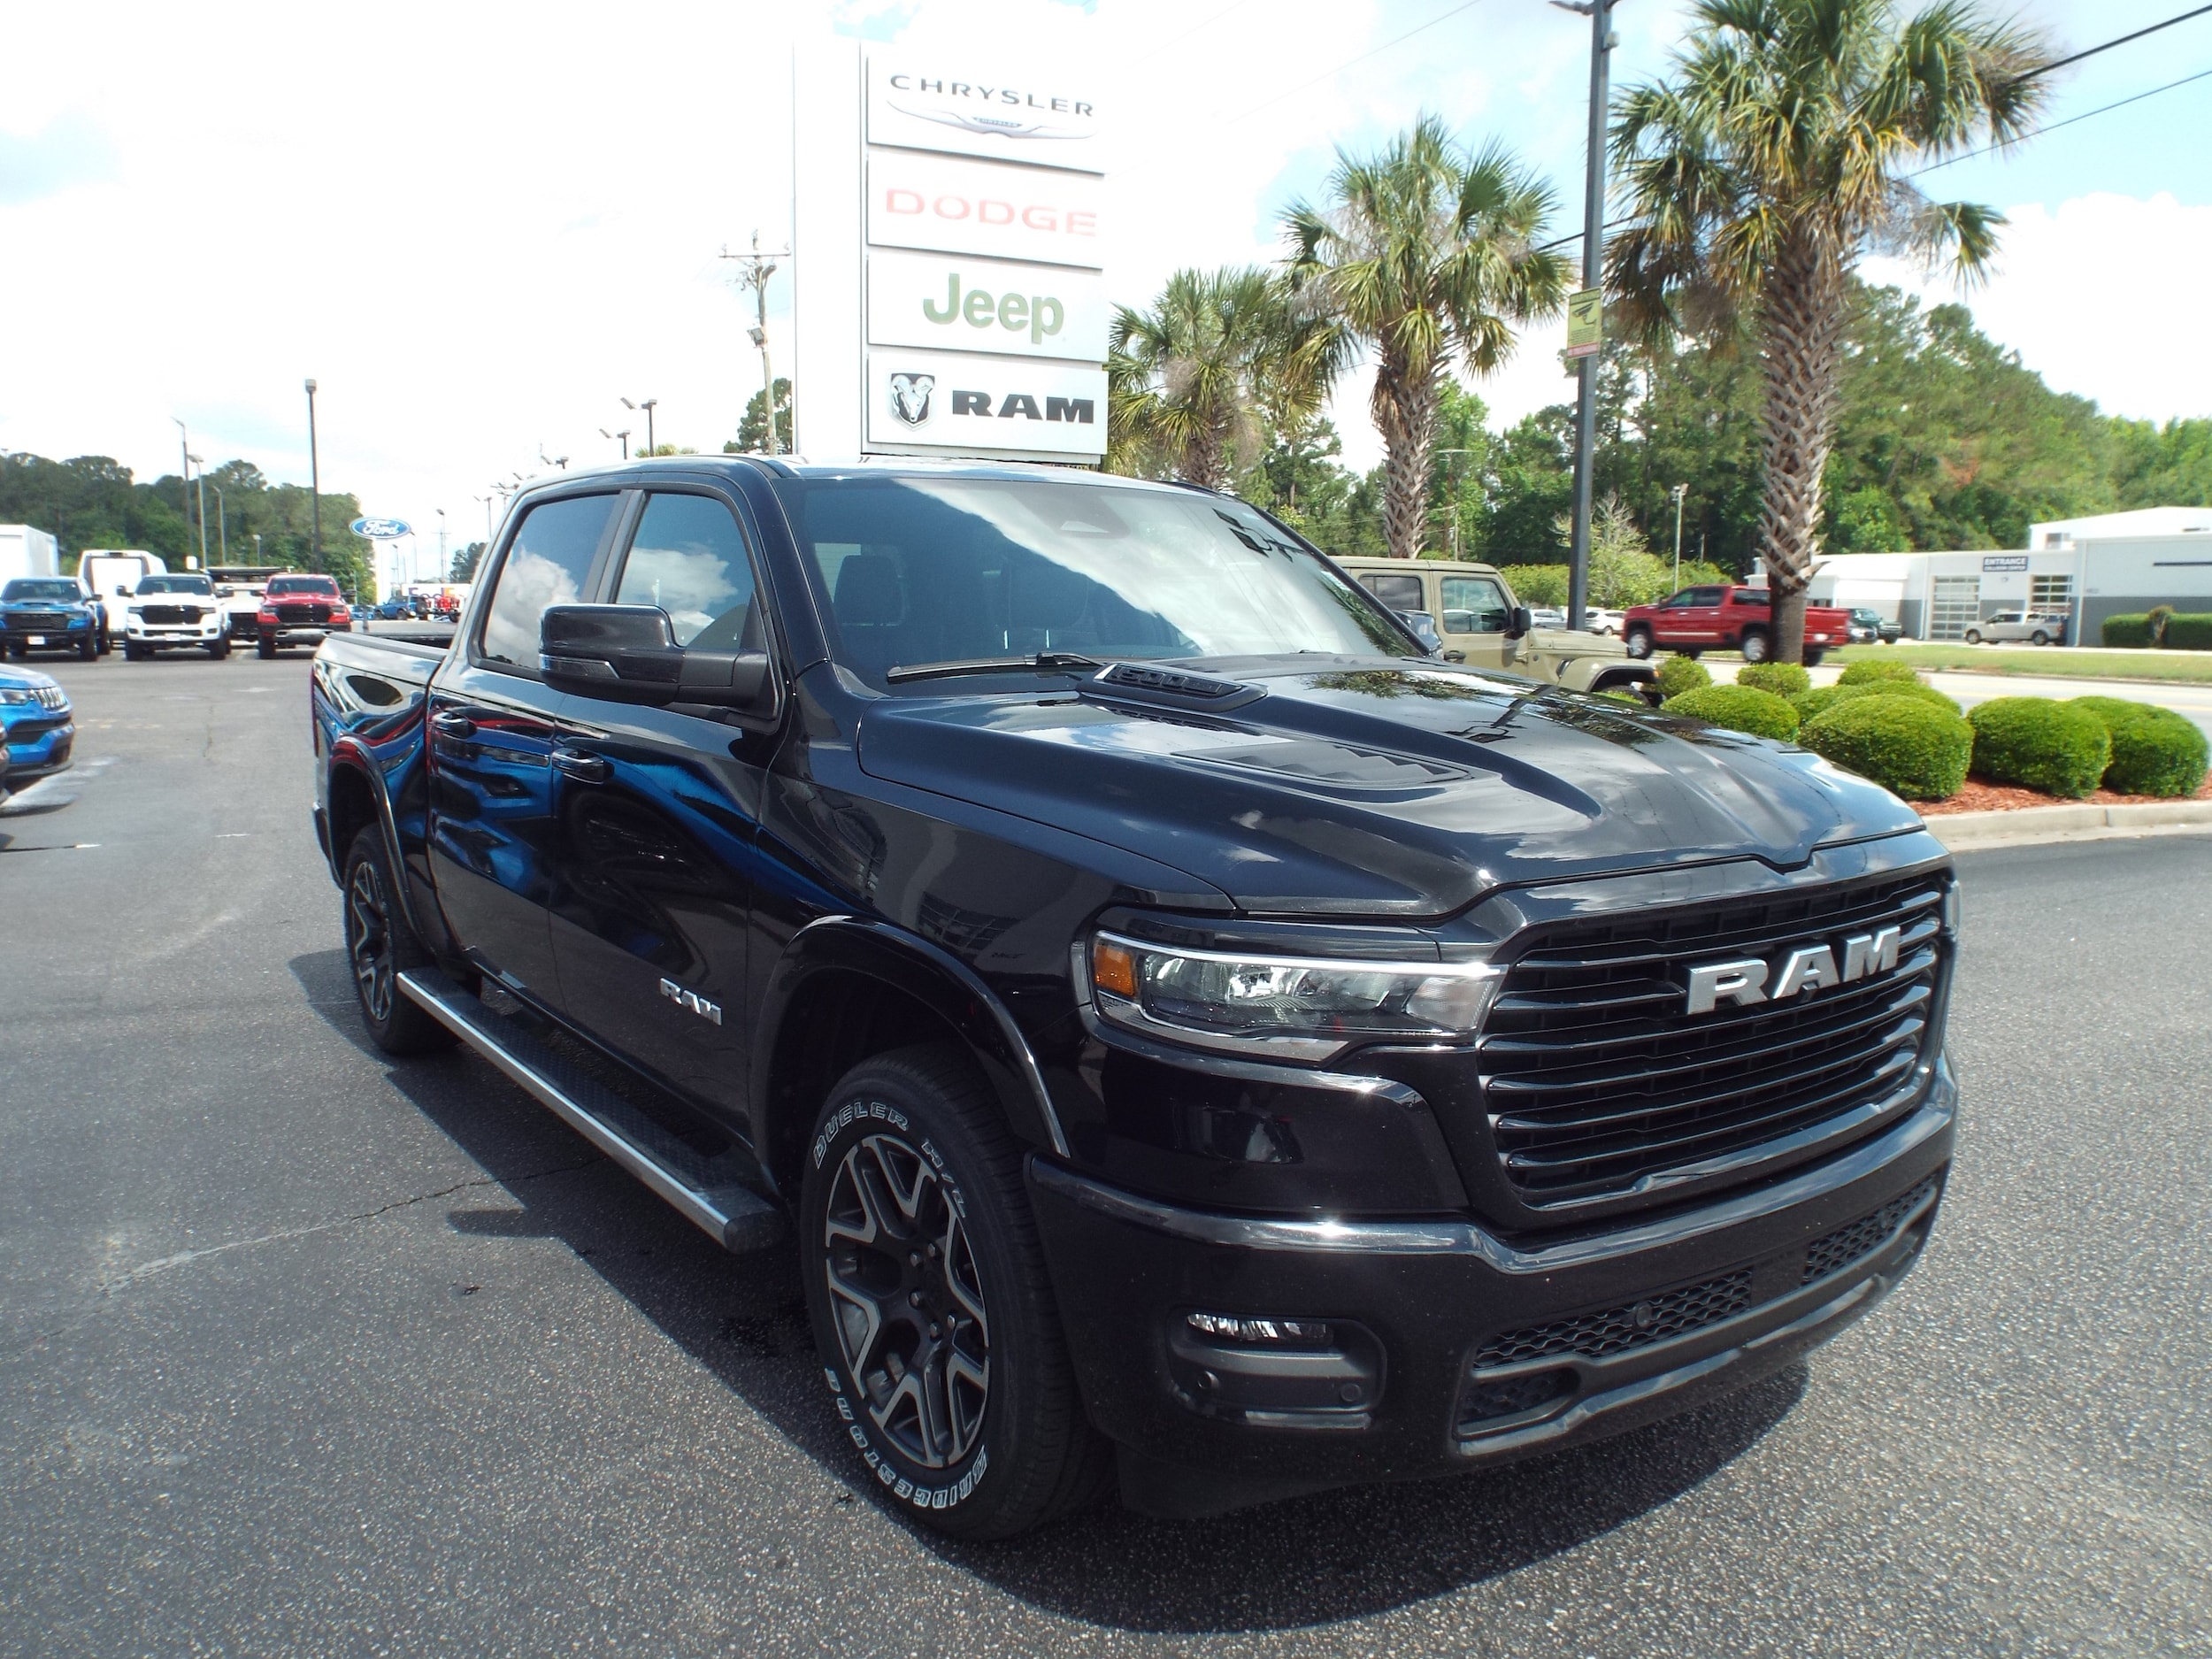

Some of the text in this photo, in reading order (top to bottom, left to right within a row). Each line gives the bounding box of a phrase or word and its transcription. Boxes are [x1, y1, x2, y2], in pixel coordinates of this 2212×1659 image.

[889, 74, 1094, 117] CHRYSLER
[886, 188, 1097, 237] DODGE
[923, 273, 1064, 345] Jeep
[952, 389, 1094, 424] RAM
[362, 518, 400, 535] Ford
[1687, 926, 1901, 1015] RAM
[660, 977, 722, 1025] RAM
[813, 1102, 910, 1170] DUELER
[825, 1367, 987, 1509] BRIDGESTONE
